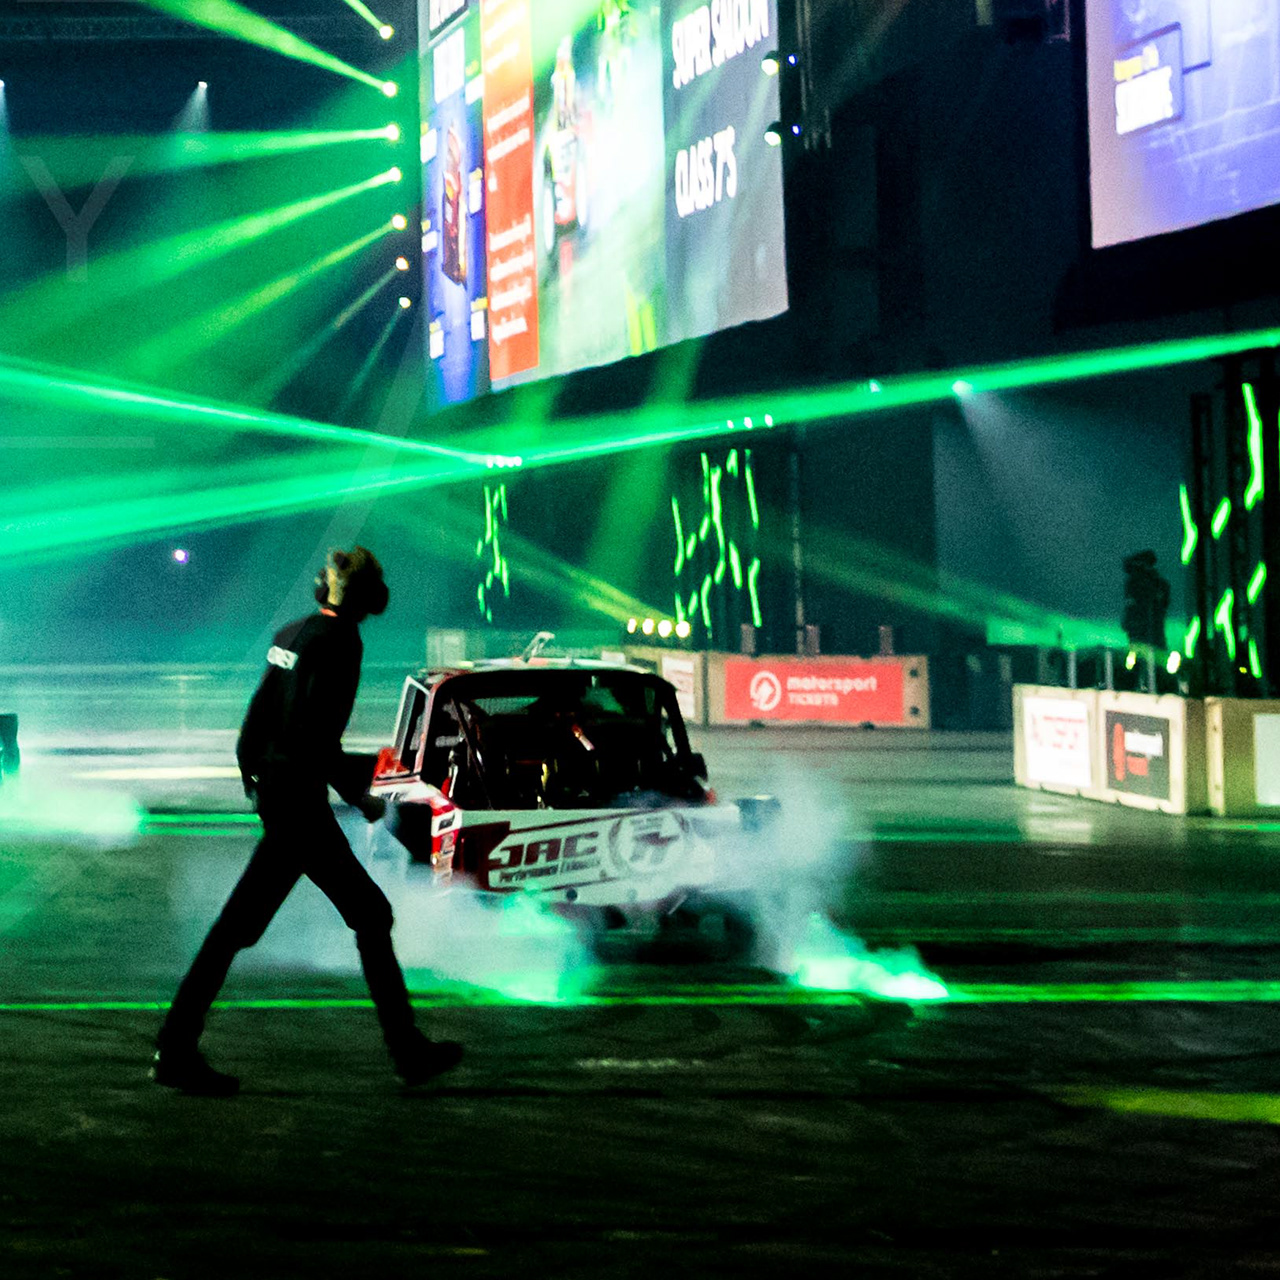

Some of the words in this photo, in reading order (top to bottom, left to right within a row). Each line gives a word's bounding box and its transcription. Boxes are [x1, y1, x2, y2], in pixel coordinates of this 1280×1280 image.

[672, 5, 711, 89] SUPER
[675, 135, 713, 218] CLASS
[787, 675, 877, 695] motorsport
[488, 831, 599, 870] JAC
